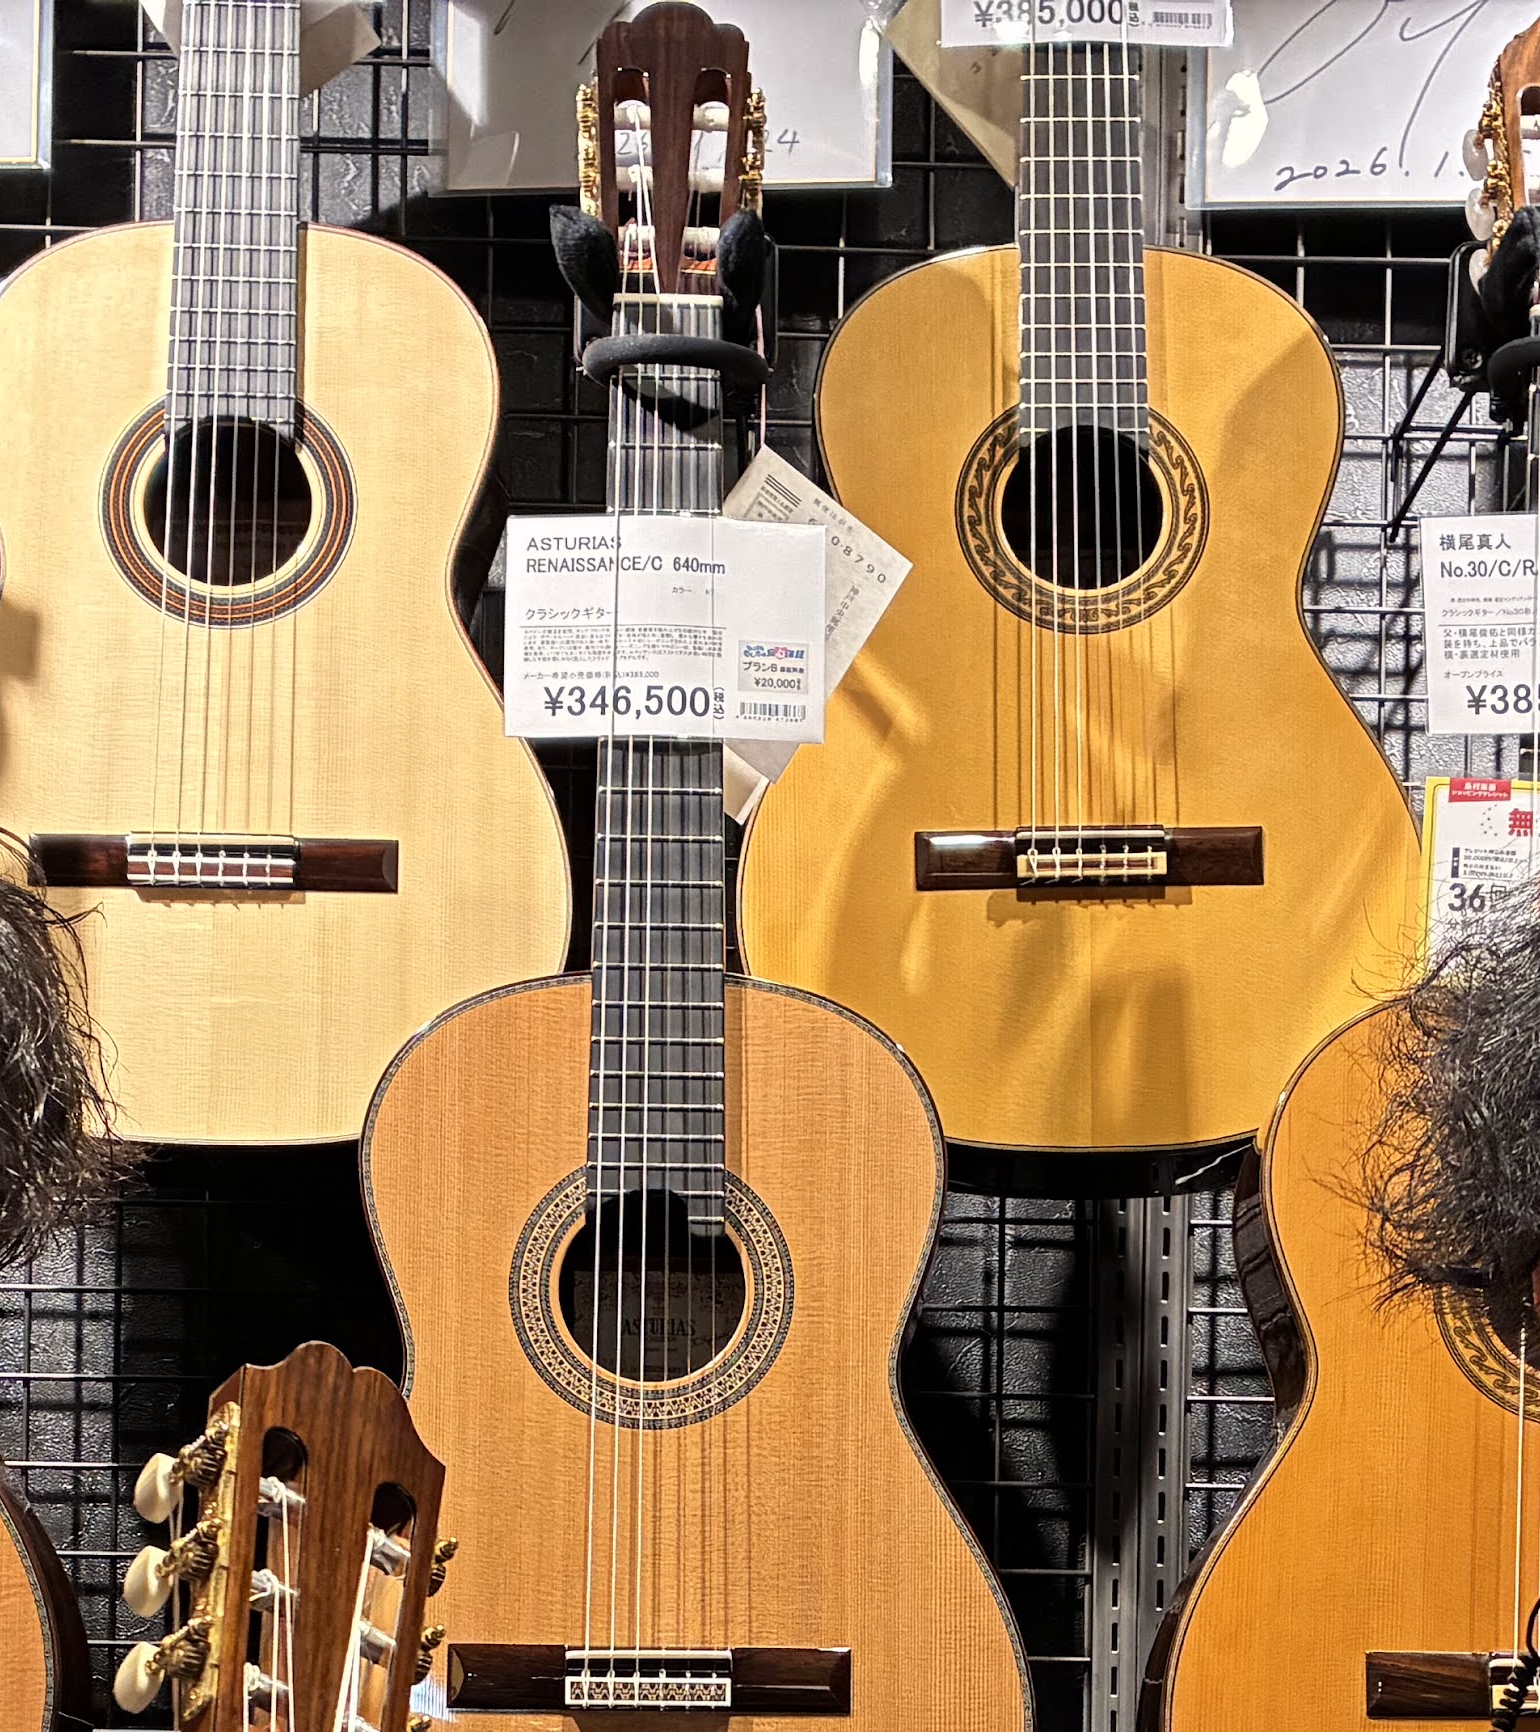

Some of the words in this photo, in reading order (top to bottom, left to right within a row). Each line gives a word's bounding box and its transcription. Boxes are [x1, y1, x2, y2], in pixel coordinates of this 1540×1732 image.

[527, 536, 622, 551] ASTURIAS
[673, 556, 726, 575] 640mm
[525, 607, 613, 621] クラシックギター
[754, 677, 796, 689] ¥20,000
[544, 685, 710, 720] ¥346,500
[1448, 882, 1486, 913] 36
